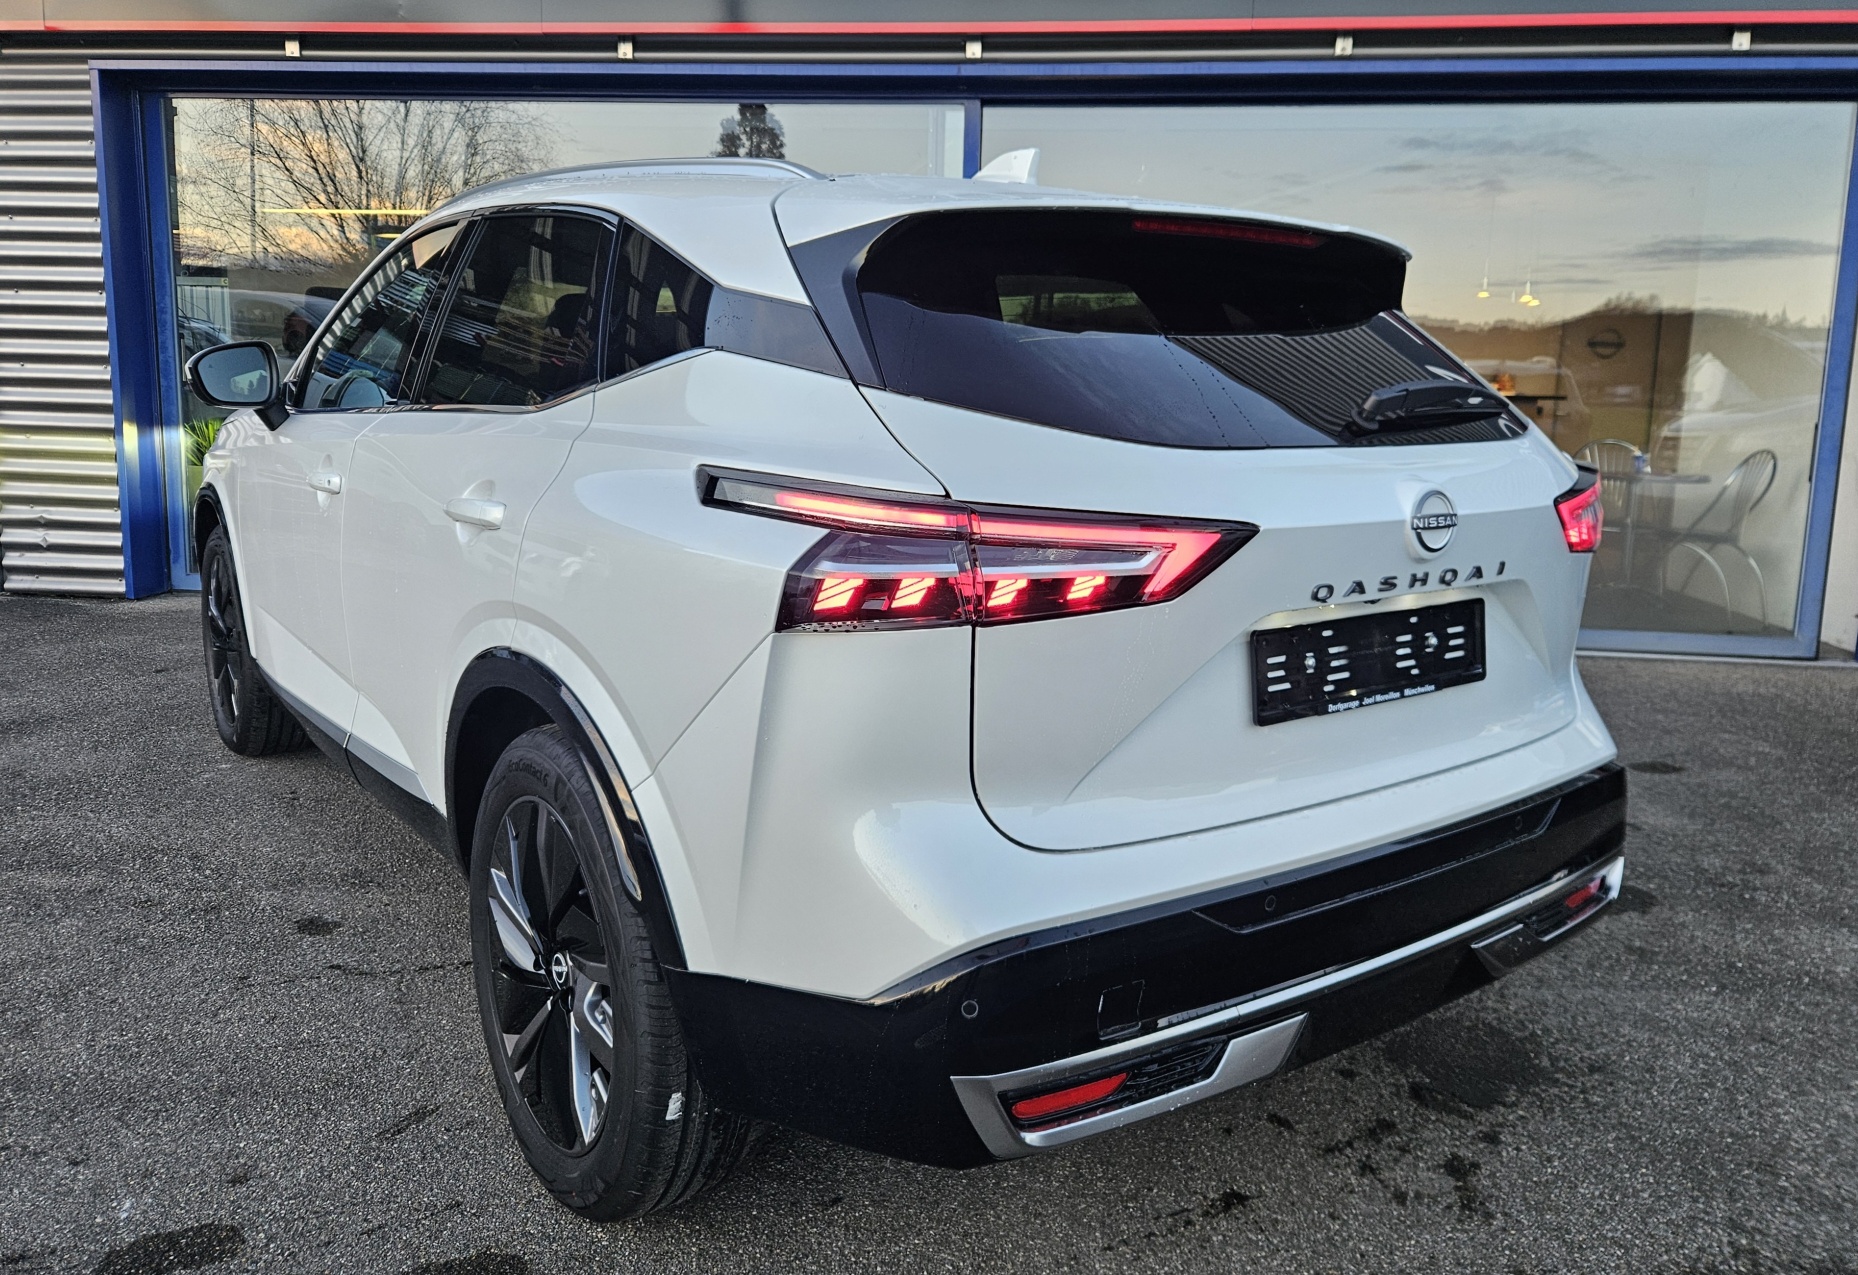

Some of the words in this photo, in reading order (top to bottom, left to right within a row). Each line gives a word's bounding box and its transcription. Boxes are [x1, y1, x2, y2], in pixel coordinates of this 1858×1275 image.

[1412, 515, 1458, 529] NISSAN
[1311, 560, 1506, 603] QASHQAI
[1328, 700, 1360, 713] Dorfgarage
